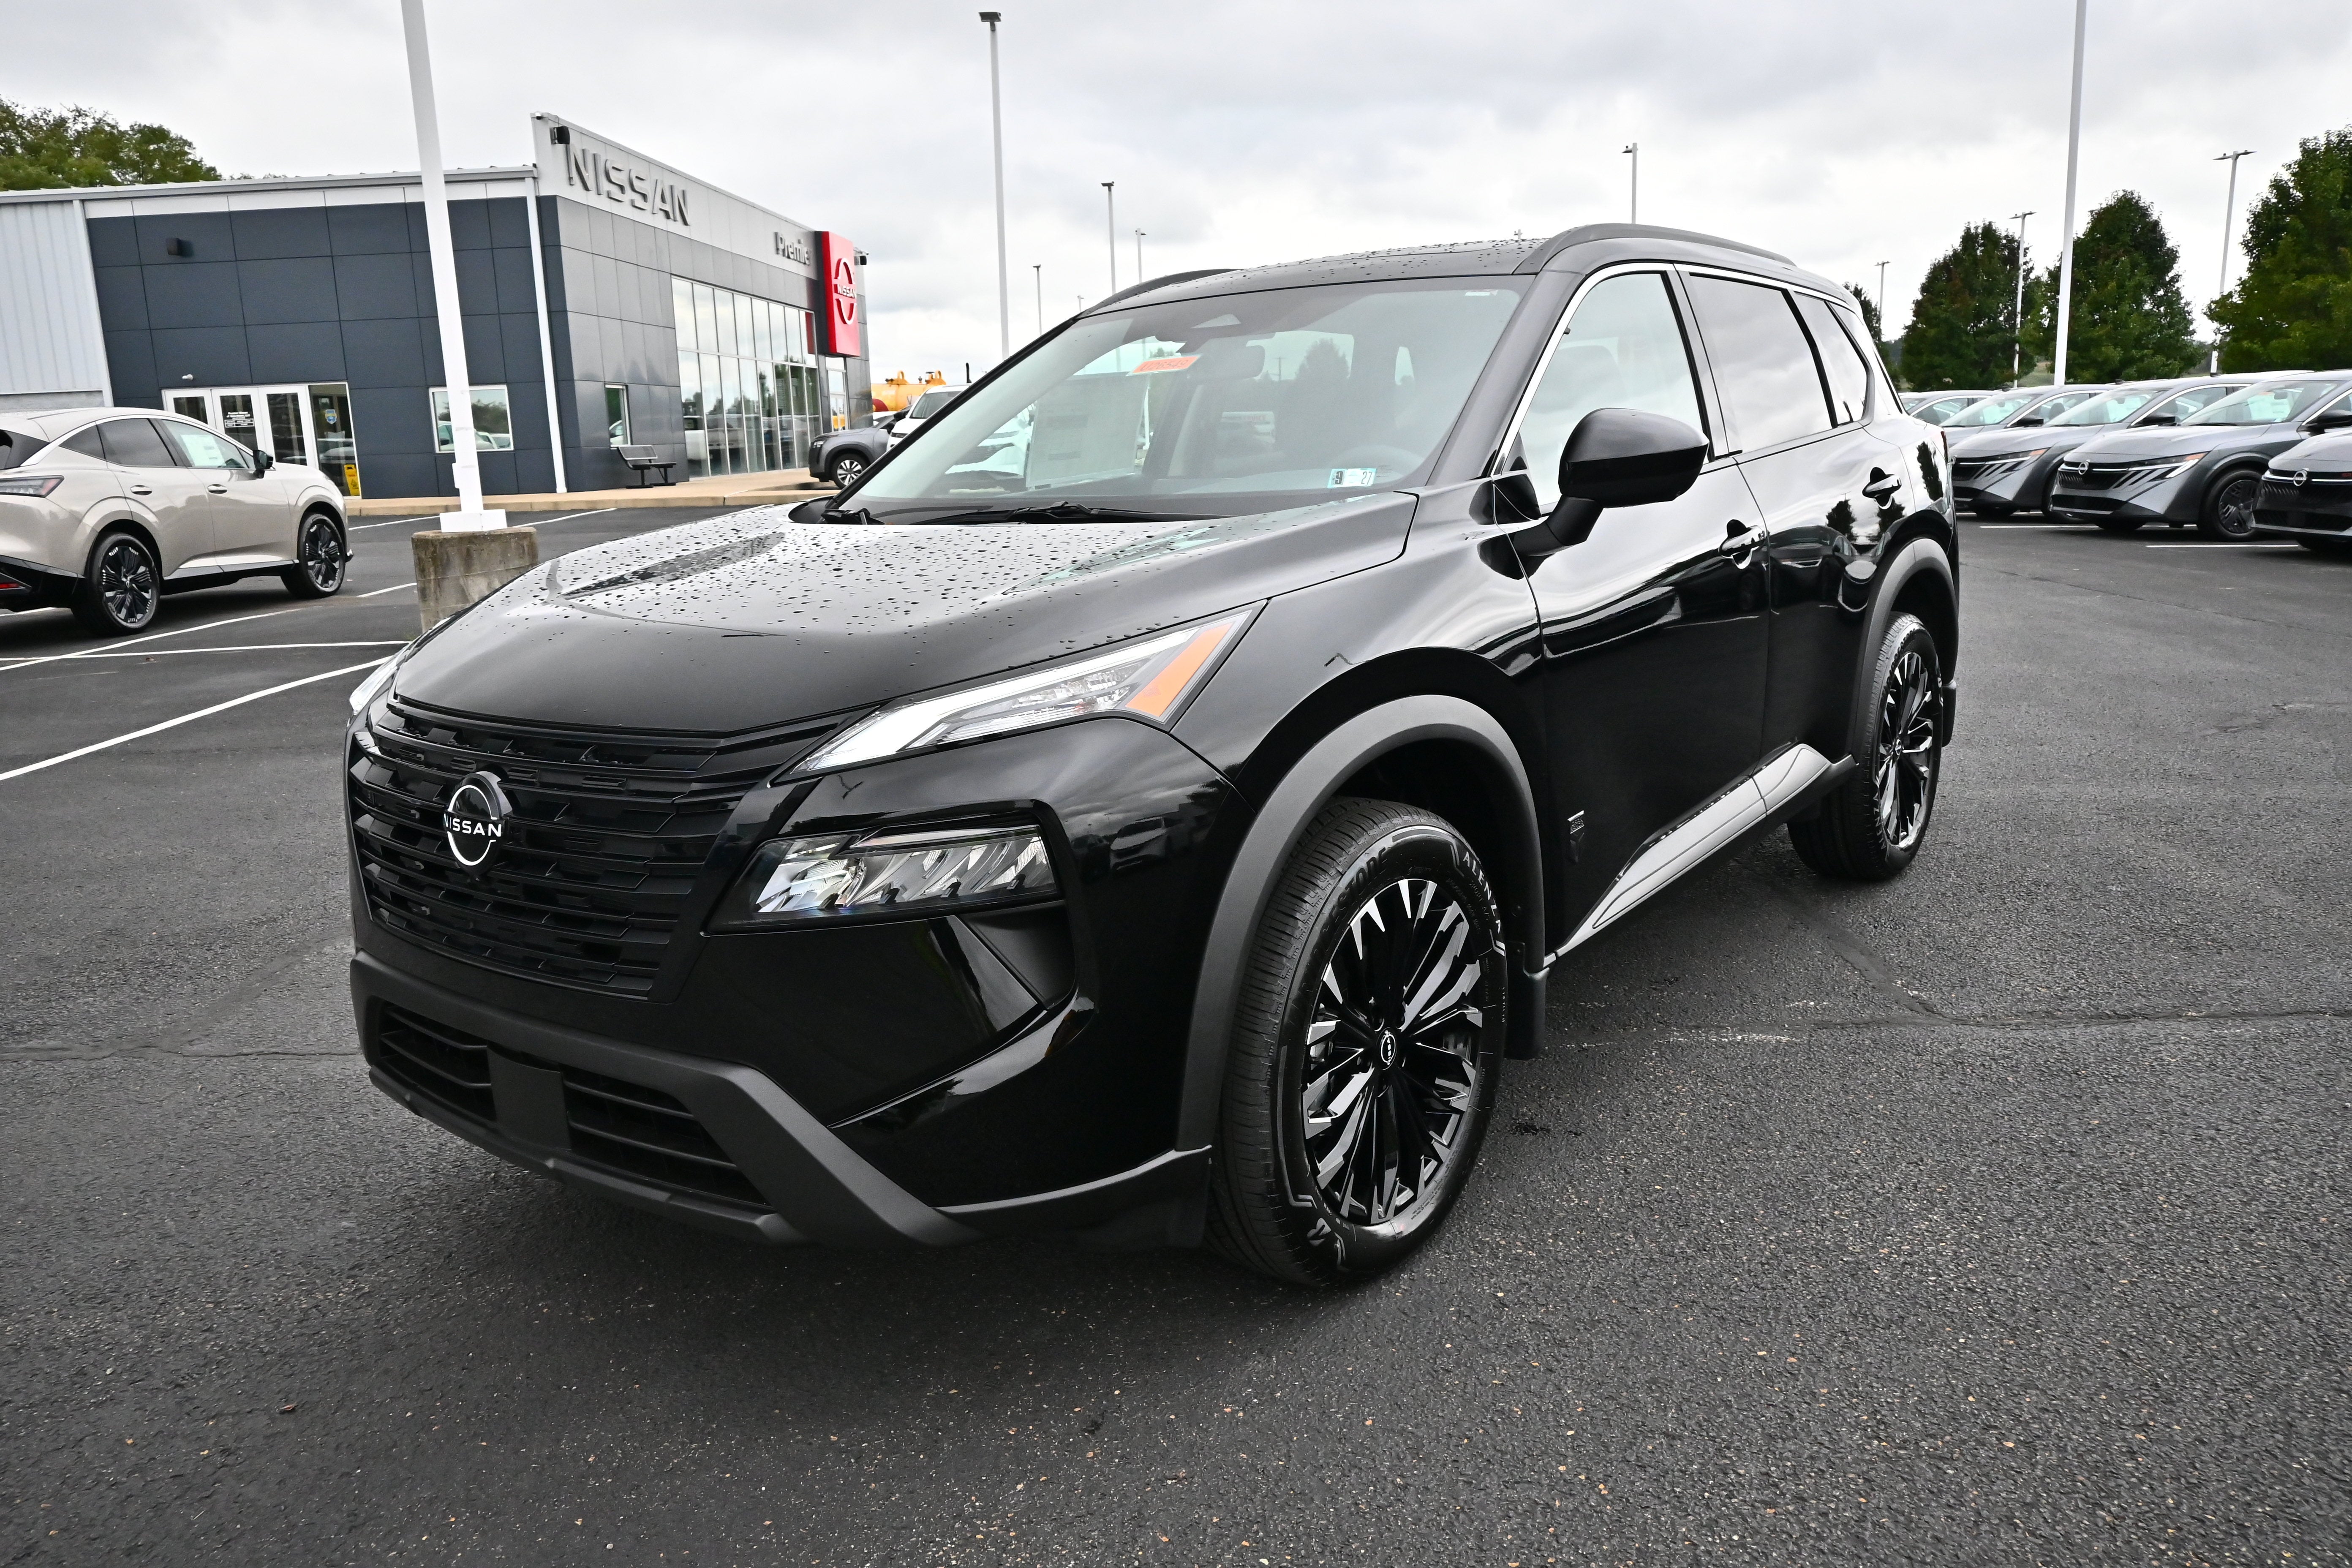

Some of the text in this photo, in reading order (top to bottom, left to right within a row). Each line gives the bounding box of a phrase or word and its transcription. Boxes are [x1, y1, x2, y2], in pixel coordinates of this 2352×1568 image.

[566, 144, 690, 226] NISSAN
[774, 231, 812, 266] Premie
[838, 284, 857, 299] NISSAN
[1335, 471, 1343, 485] 9
[1361, 471, 1372, 485] 27
[444, 813, 502, 837] NISSAN
[1462, 851, 1502, 934] ALENZA
